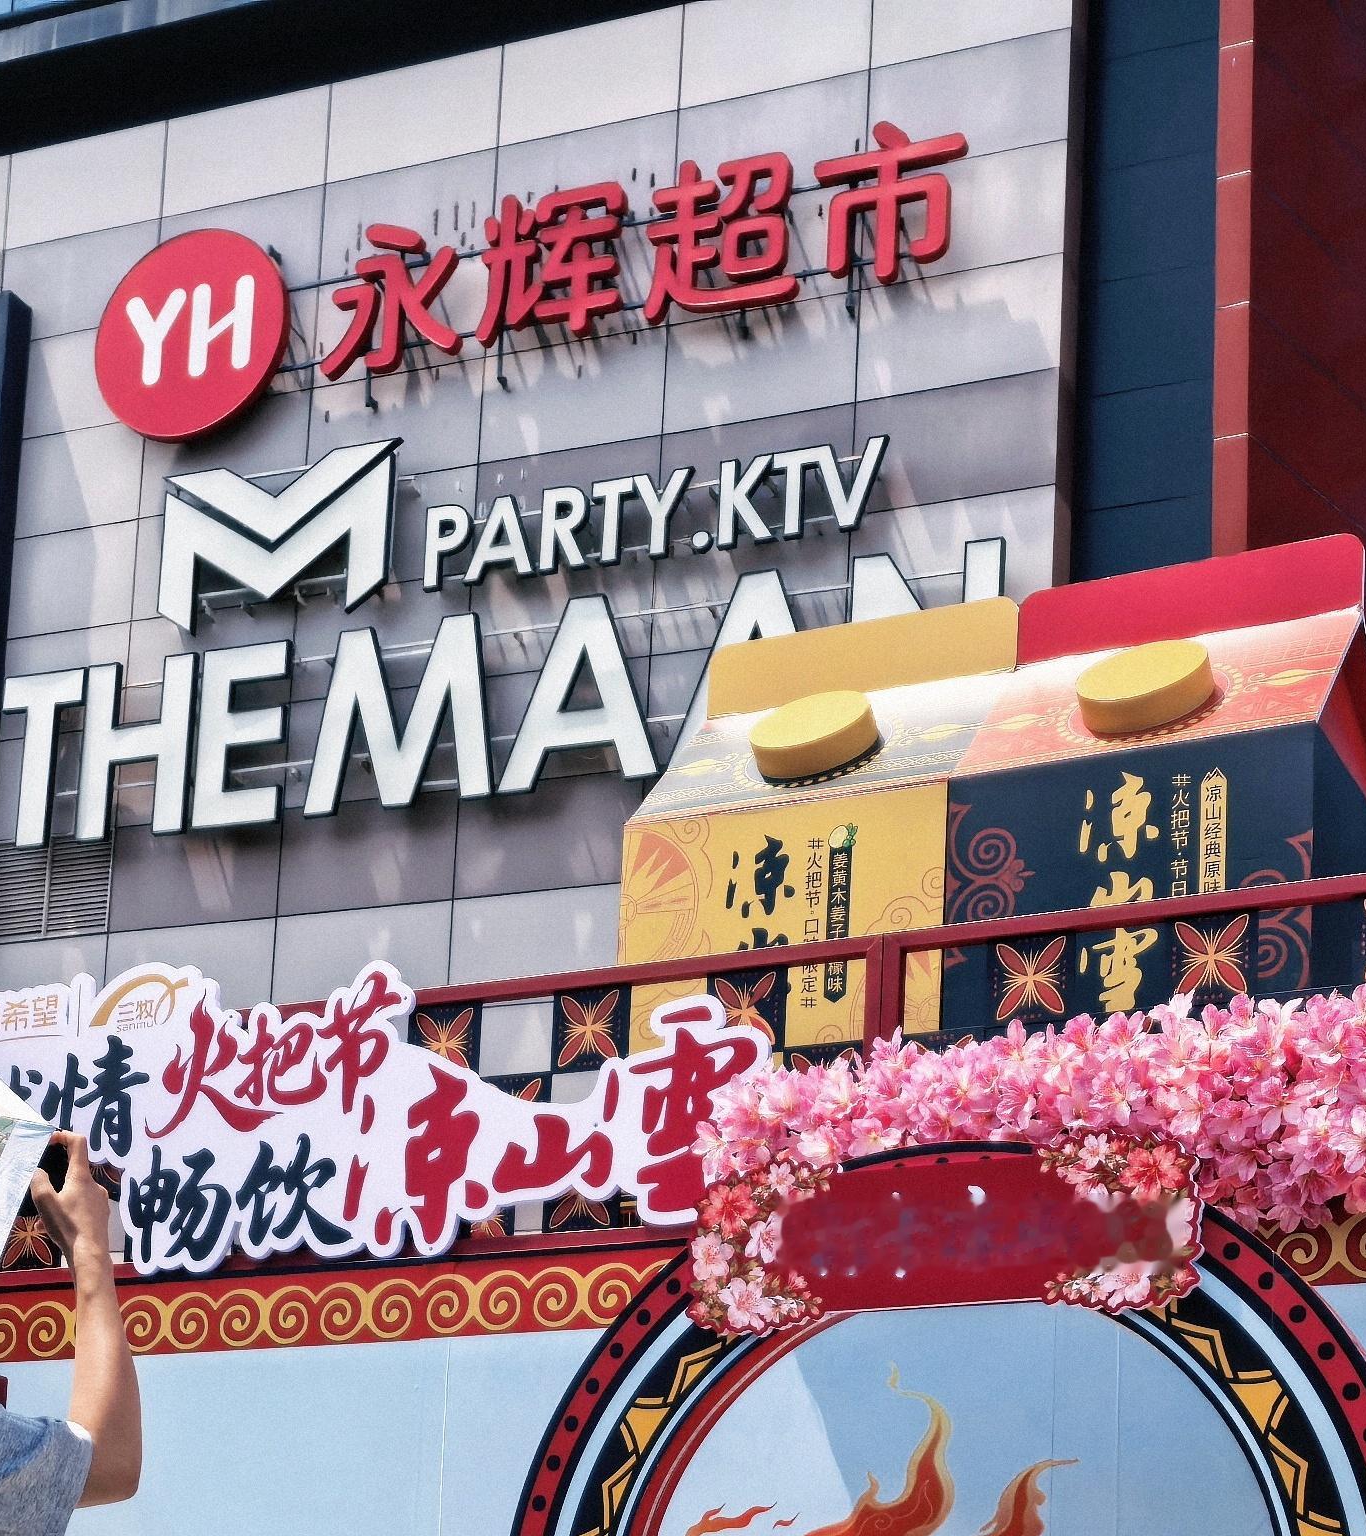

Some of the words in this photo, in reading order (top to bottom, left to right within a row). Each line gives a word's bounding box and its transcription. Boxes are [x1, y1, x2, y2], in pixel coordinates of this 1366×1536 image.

[320, 121, 969, 381] 永辉超市
[125, 273, 256, 387] YH
[424, 434, 890, 591] PARTY.KTV
[826, 852, 849, 993] 姜黄木姜子檬味
[116, 1020, 155, 1033] sanmu
[117, 999, 155, 1023] 三牧
